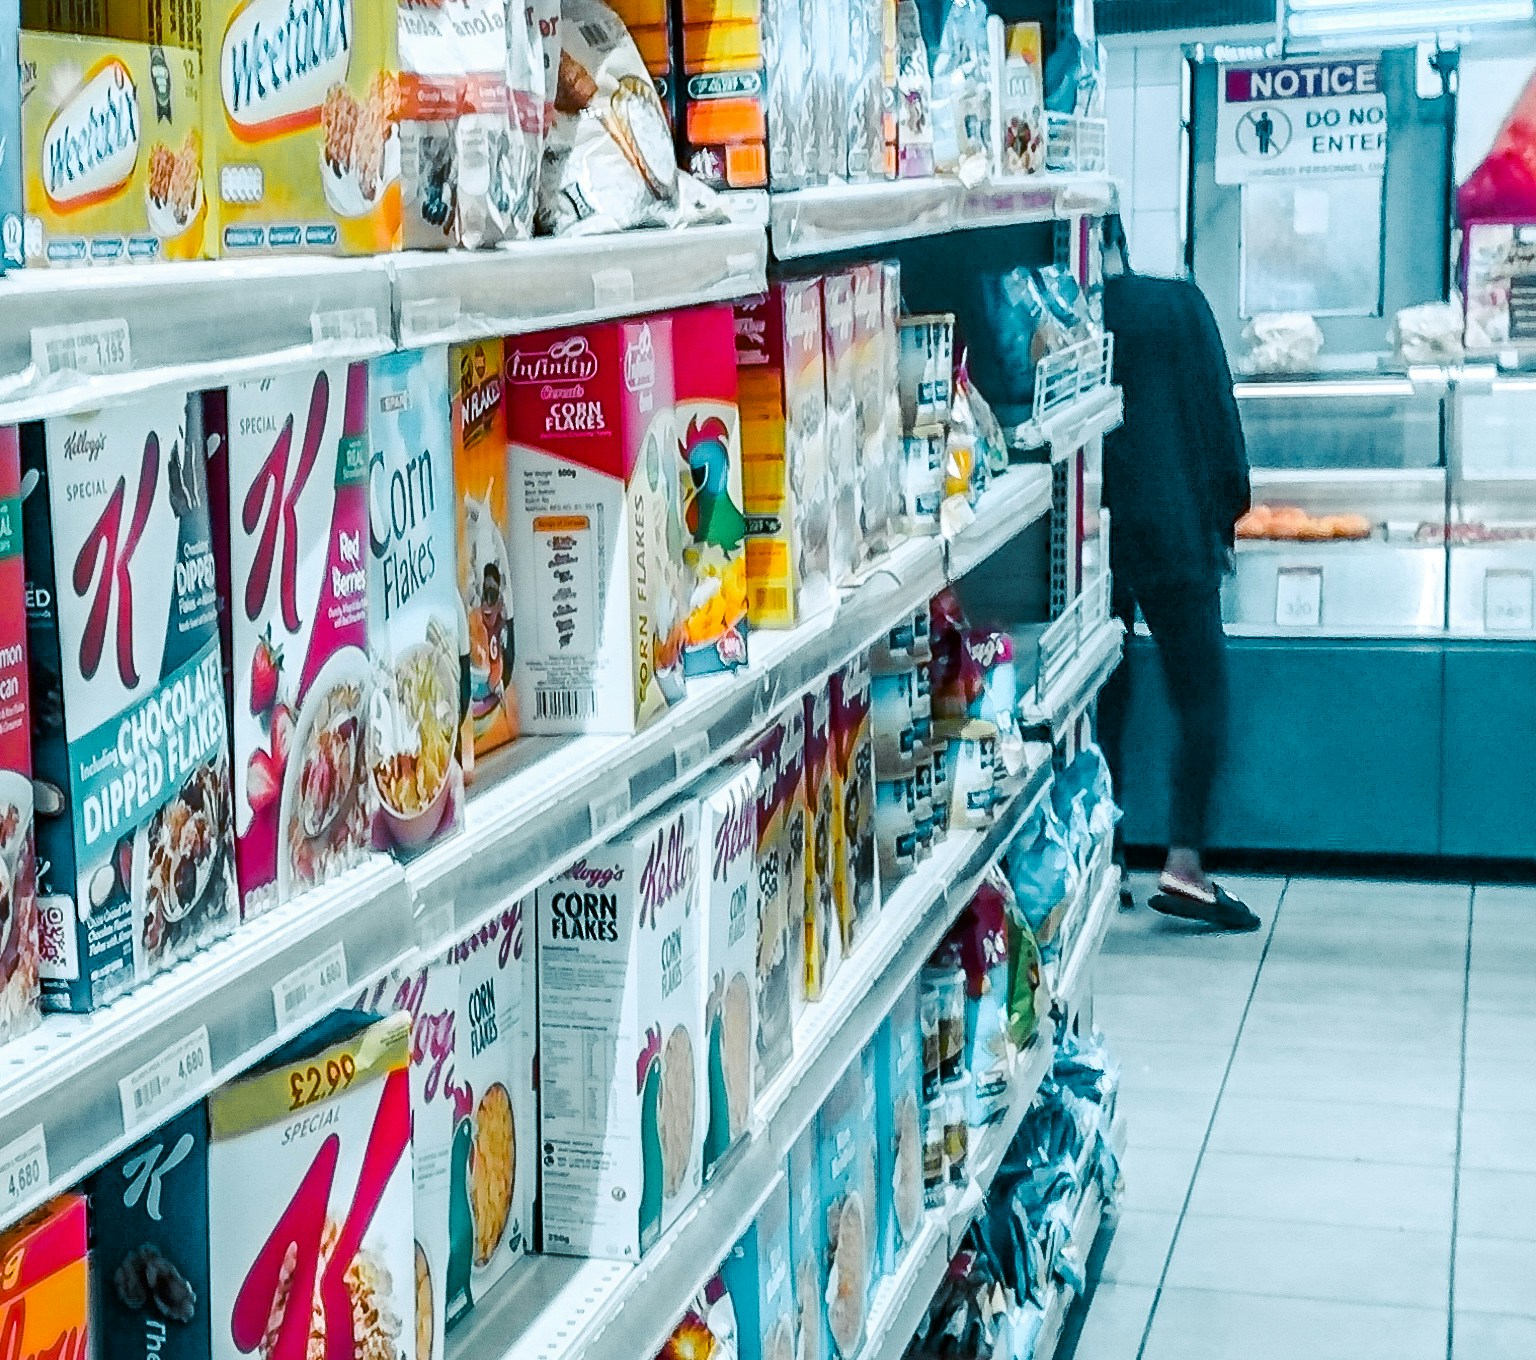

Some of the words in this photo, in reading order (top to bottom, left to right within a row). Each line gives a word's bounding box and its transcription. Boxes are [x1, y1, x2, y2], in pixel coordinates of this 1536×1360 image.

[1249, 62, 1378, 100] NOTICE
[1305, 110, 1342, 130] DO
[1348, 104, 1387, 126] NO
[48, 84, 140, 195] Weetabix
[513, 351, 593, 380] Infinity
[239, 414, 277, 436] SPECIAL
[545, 414, 606, 432] FLAKES
[549, 400, 602, 418] CORN
[66, 478, 109, 503] SPECIAL
[368, 445, 435, 558] Corn
[72, 429, 162, 691] K
[338, 529, 361, 563] Red
[632, 492, 646, 605] FLAKES
[175, 555, 217, 598] DIPPED
[331, 563, 368, 597] Berries
[380, 535, 437, 622] Flakes
[79, 743, 120, 783] Including
[116, 652, 221, 764] CHOCOLATE
[82, 753, 164, 843] DIPPED
[165, 704, 225, 772] FLAKES
[550, 891, 618, 921] CORN
[550, 917, 619, 943] FLAKES
[660, 924, 684, 967] CORN
[467, 976, 497, 1028] CORN
[469, 1020, 499, 1059] FLAKES
[177, 1046, 205, 1082] 4,680
[288, 1051, 358, 1114] £2.99
[281, 1104, 342, 1148] SPECIAL
[6, 1158, 41, 1199] 4,680
